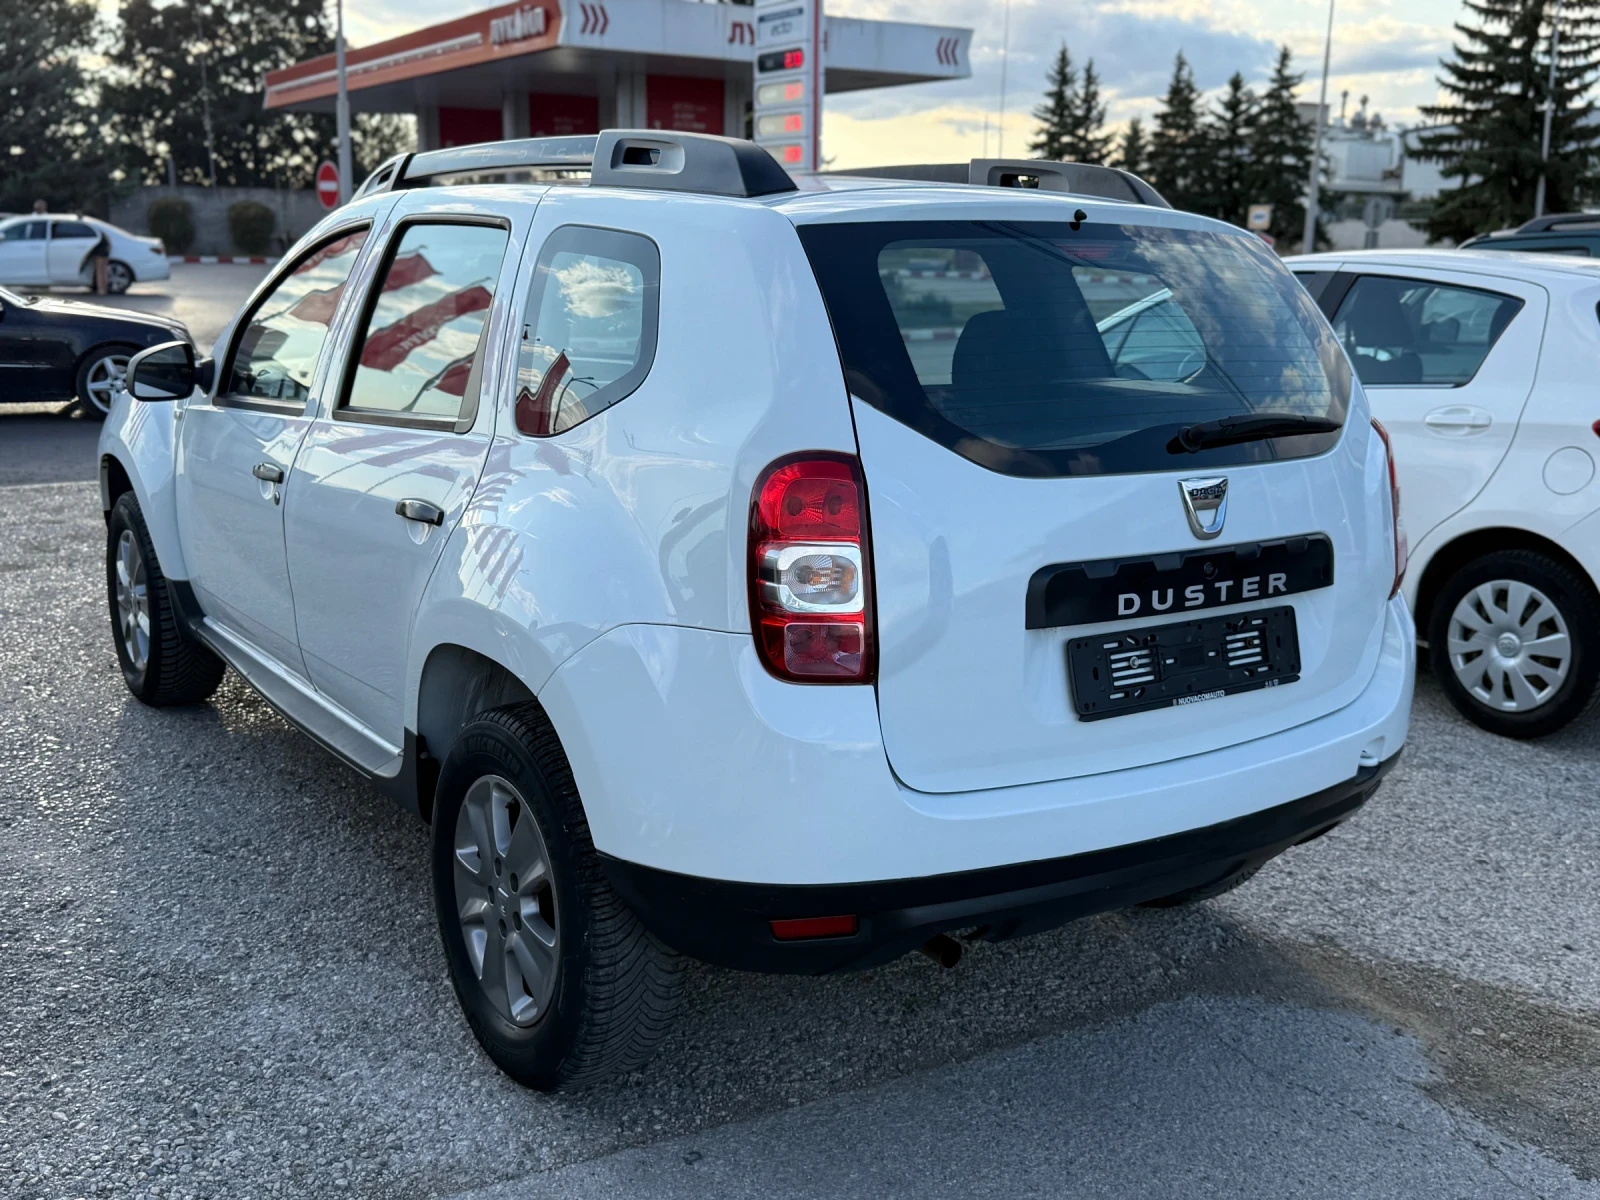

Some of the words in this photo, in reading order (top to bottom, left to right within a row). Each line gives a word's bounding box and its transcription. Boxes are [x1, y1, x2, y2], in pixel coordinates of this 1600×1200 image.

[1191, 484, 1224, 497] DACIA
[1118, 573, 1287, 616] DUSTER
[1178, 689, 1225, 706] NUOVACOMAUTO
[467, 736, 521, 774] MICHELIN
